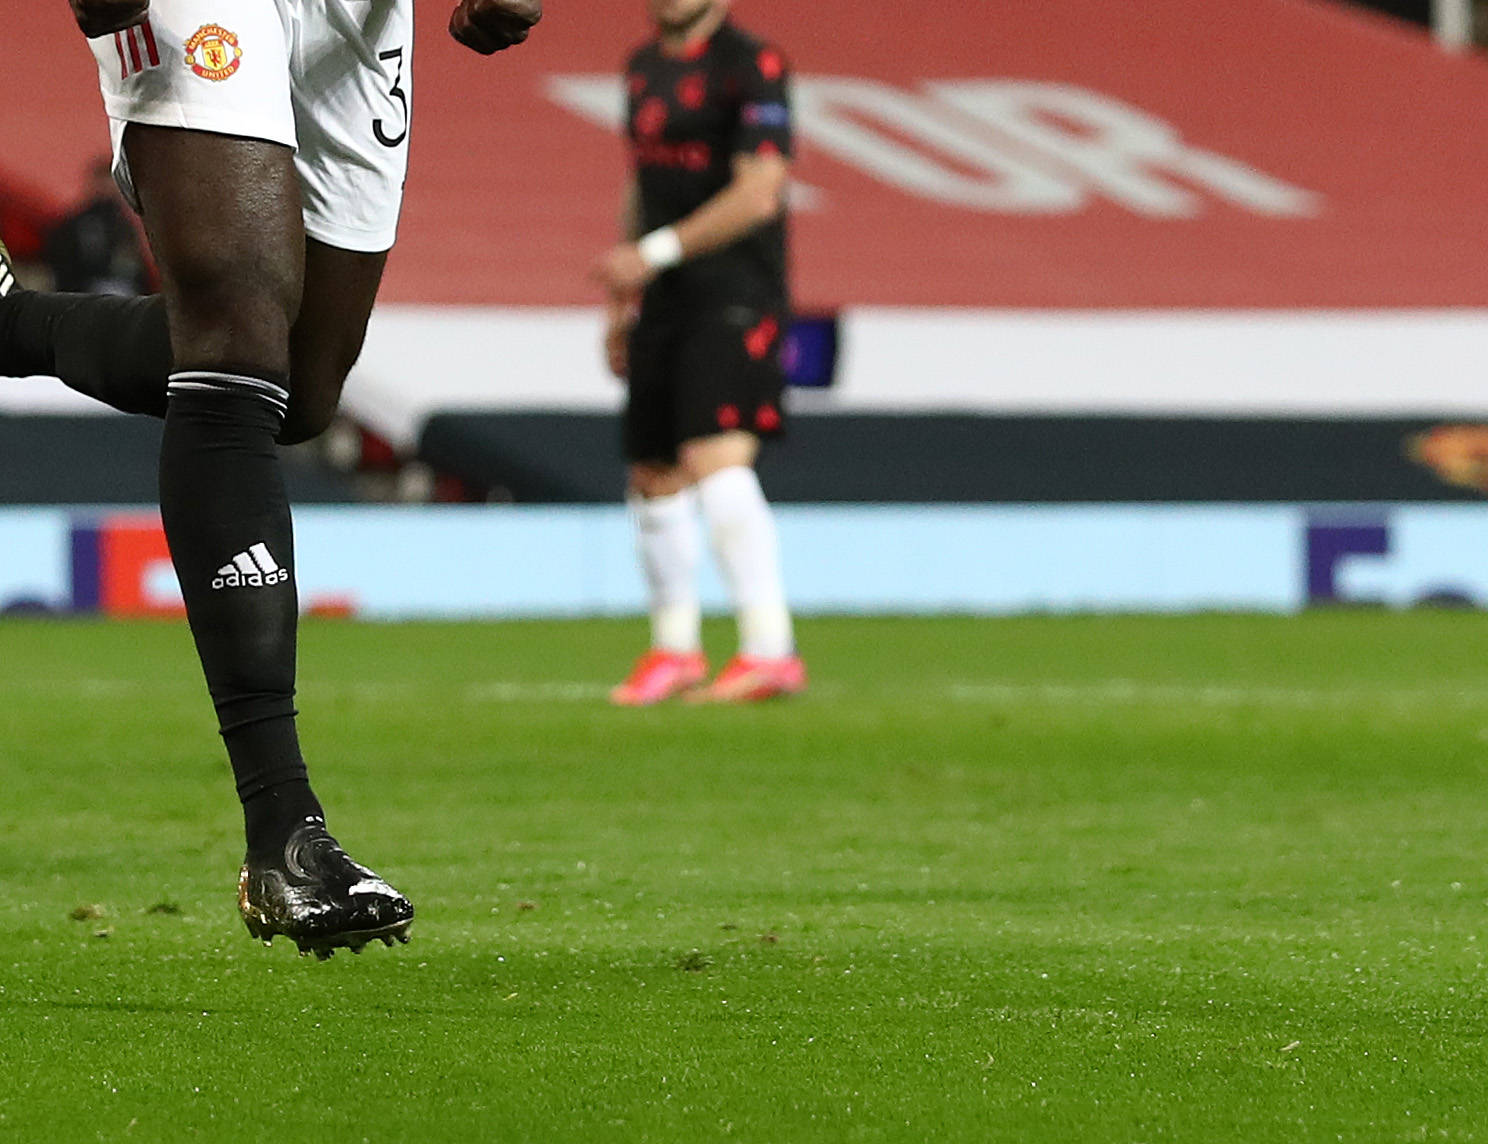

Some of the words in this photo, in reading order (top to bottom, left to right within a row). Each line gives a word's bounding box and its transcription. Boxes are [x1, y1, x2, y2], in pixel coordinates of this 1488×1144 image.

[187, 26, 236, 50] MANCHESTER
[200, 64, 235, 79] UNITED
[372, 46, 407, 148] 3
[212, 567, 289, 590] adidas
